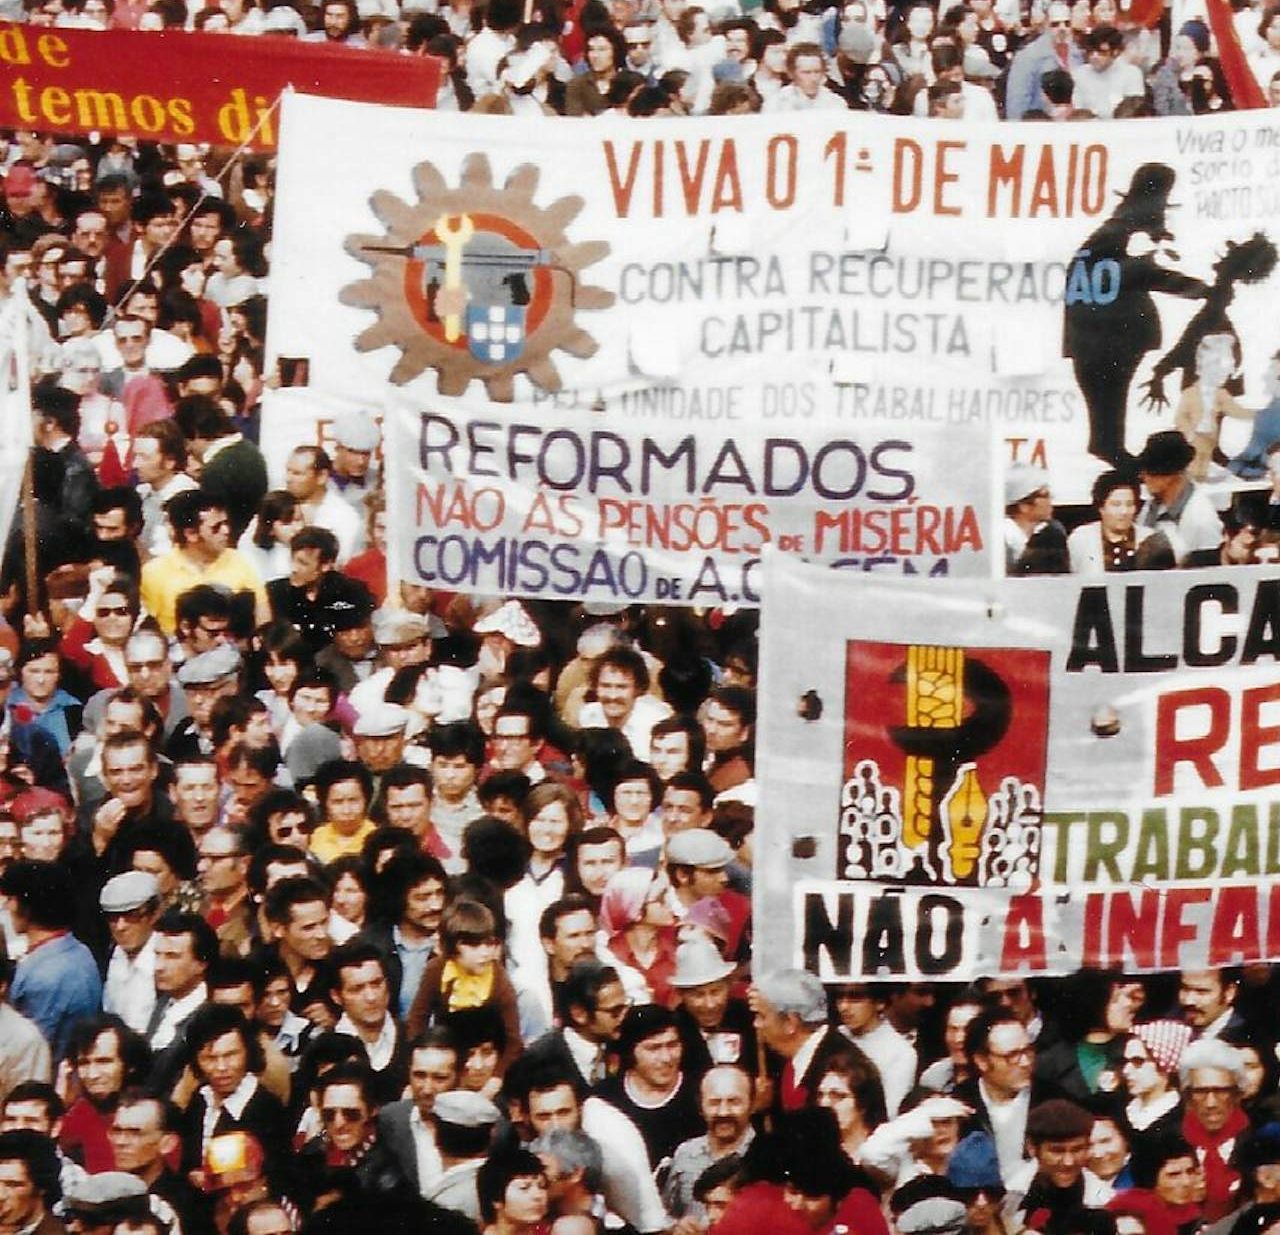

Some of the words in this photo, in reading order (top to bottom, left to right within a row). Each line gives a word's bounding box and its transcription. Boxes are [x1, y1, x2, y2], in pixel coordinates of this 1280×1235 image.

[12, 76, 195, 135] temos
[603, 138, 744, 219] VIVA
[765, 133, 799, 211] O
[891, 139, 963, 216] DE
[987, 142, 1109, 219] MAIO
[618, 255, 787, 307] CONTRA
[808, 248, 1122, 308] RECUPERAÇÃO
[699, 308, 972, 360] CAPITALISTA
[620, 383, 743, 421] UNIDADE
[761, 384, 815, 420] DOS
[834, 381, 1077, 425] TRABALHADORES
[418, 411, 917, 503] REFORMADOS
[416, 478, 506, 532] NÃO
[600, 496, 772, 554] PENSÕES
[778, 534, 804, 552] DE
[814, 495, 984, 556] MISÉRIA
[656, 578, 681, 600] DE
[801, 886, 965, 977] NÃO
